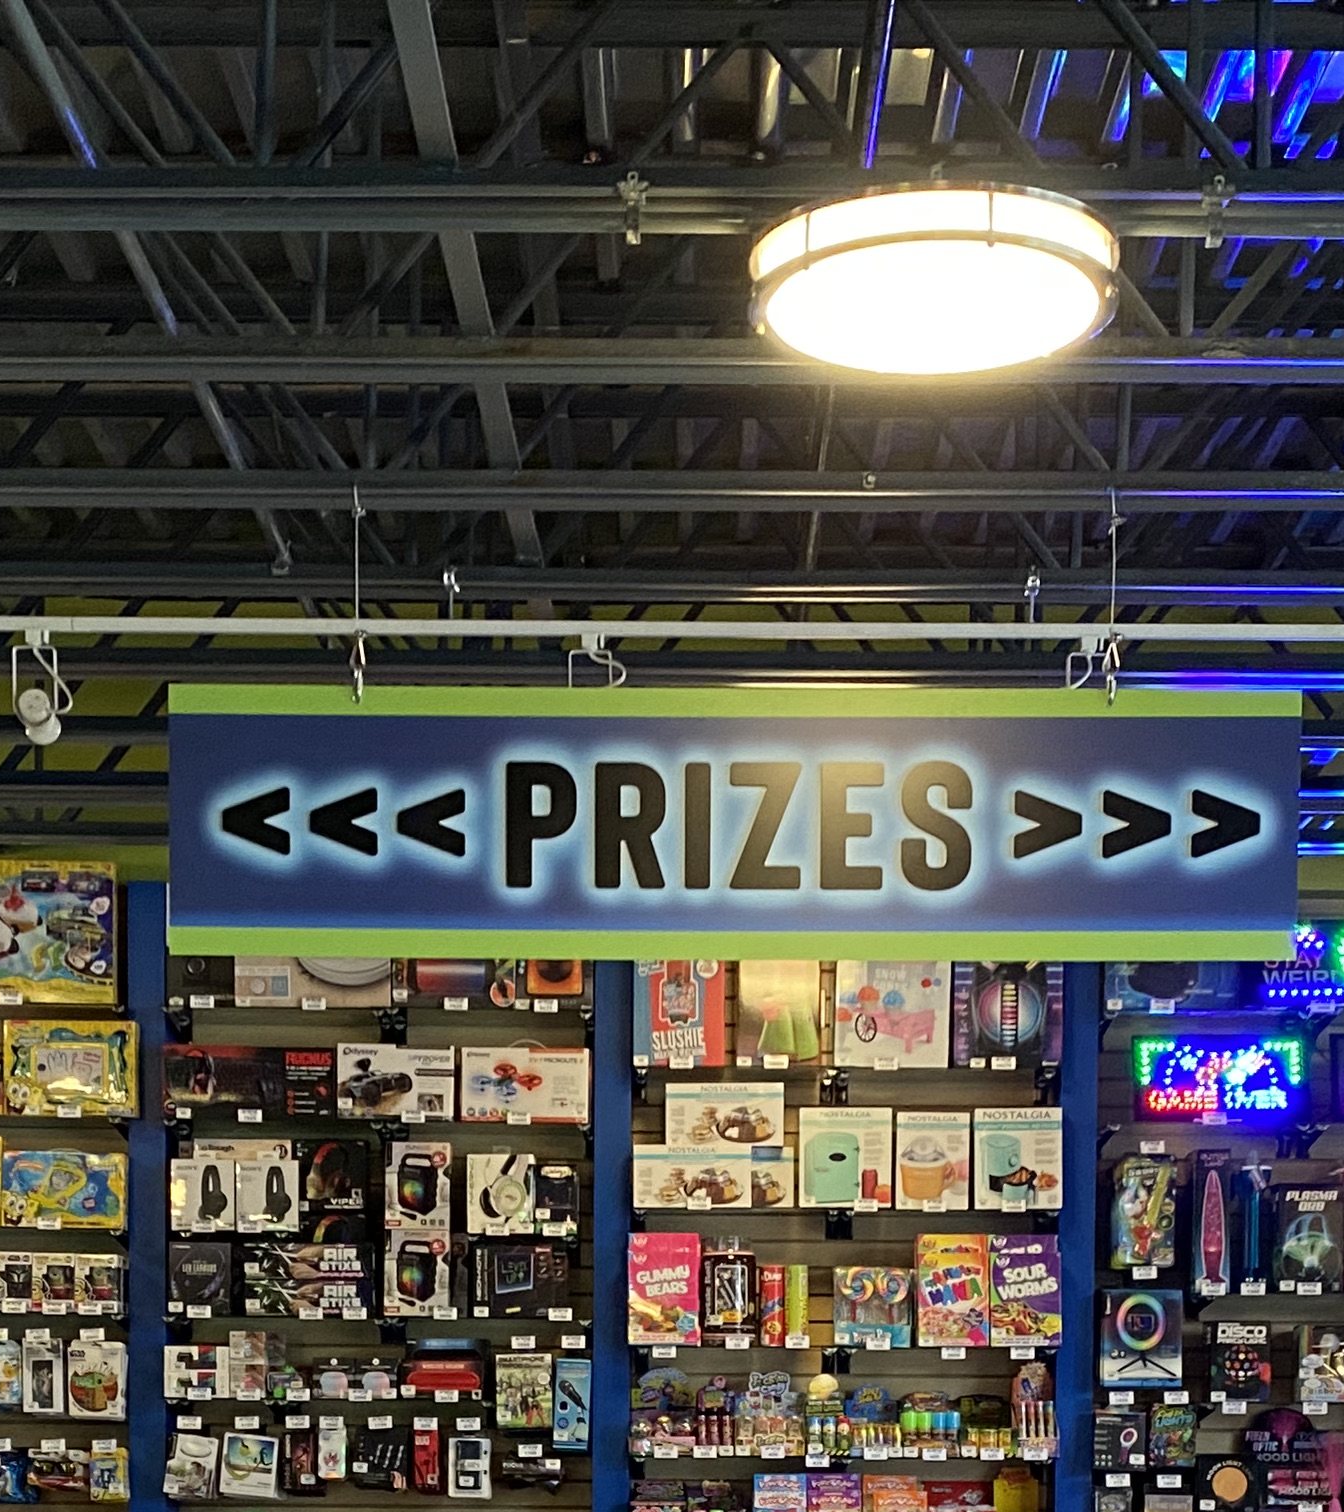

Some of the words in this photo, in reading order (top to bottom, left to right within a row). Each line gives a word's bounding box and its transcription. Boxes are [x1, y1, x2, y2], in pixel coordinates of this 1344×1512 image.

[504, 760, 974, 892] PRIZES
[652, 1027, 705, 1051] SLUSHIE
[343, 1046, 379, 1057] Odyssey
[701, 1085, 748, 1093] NOSTALGIA
[982, 1110, 1051, 1120] NOSTALGIA
[668, 1146, 716, 1154] NOSTALGIA
[1285, 1190, 1339, 1201] PLASMA
[331, 1198, 363, 1206] VIPER
[1298, 1201, 1326, 1212] ORB
[323, 1247, 357, 1261] AIR
[636, 1264, 690, 1285] GUMMY
[1003, 1262, 1047, 1283] SOUR
[323, 1285, 357, 1297] AIR
[645, 1280, 688, 1298] BEARS
[997, 1276, 1058, 1301] WORMS
[1217, 1325, 1268, 1338] DISCO
